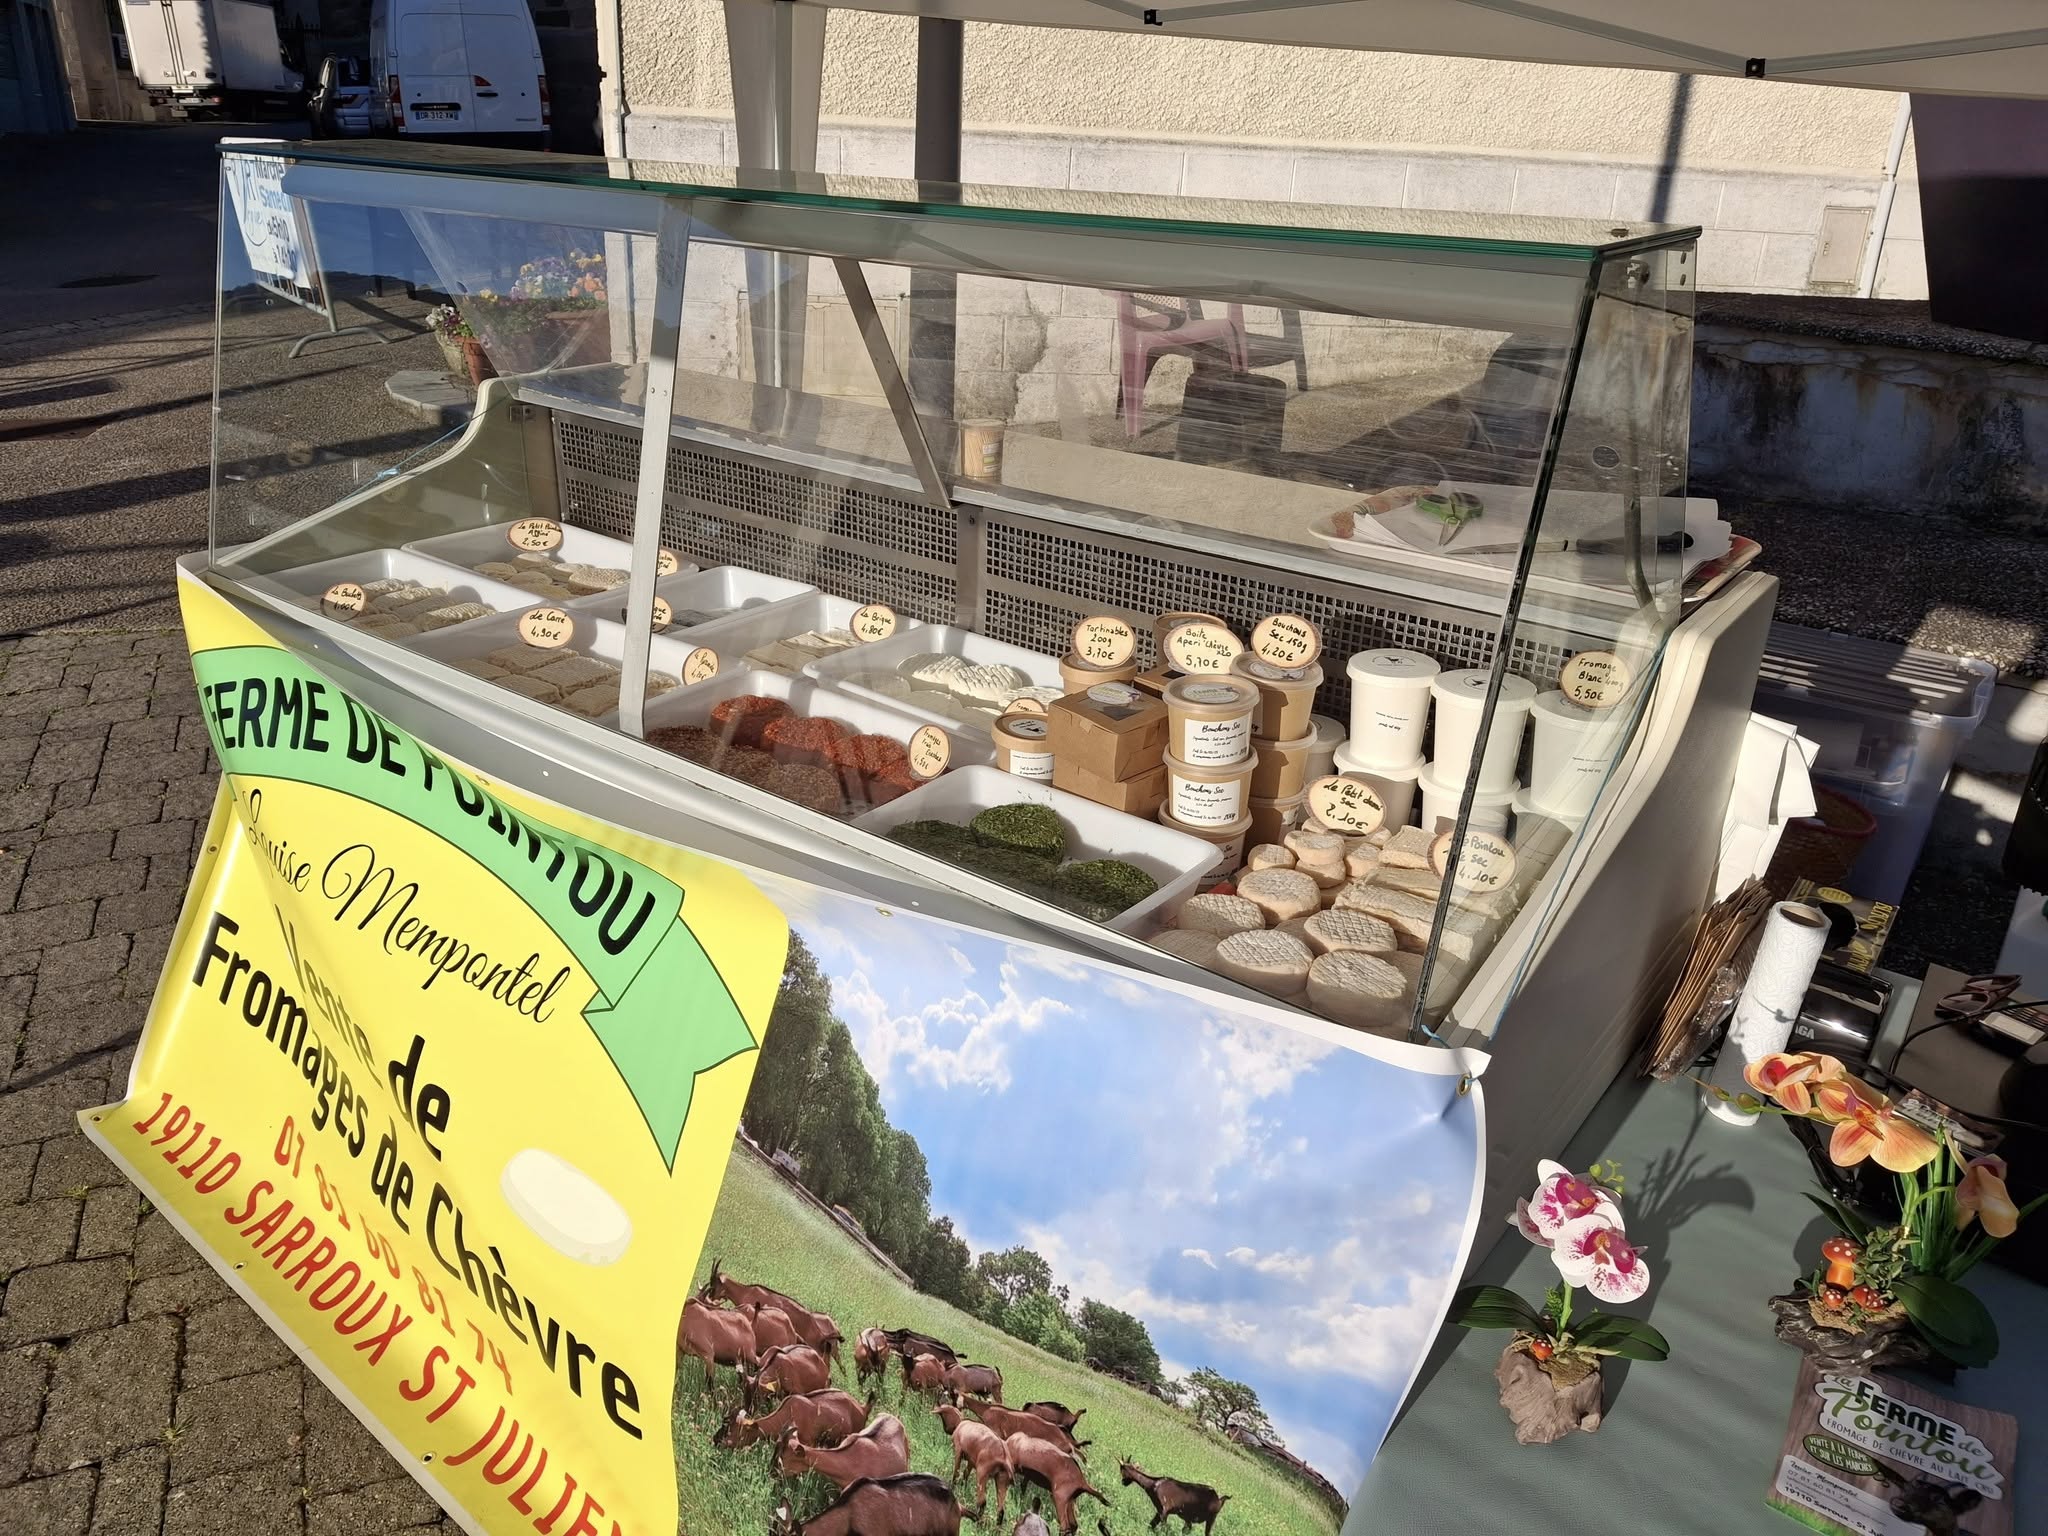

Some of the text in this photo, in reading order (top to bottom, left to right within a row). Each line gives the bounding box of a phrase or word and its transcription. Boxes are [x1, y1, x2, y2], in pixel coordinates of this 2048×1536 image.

[546, 610, 568, 624] Carré
[1578, 670, 1602, 683] Blanc
[203, 676, 657, 957] FERME DE POINTOU
[1470, 835, 1506, 858] Pointou
[242, 787, 572, 1023] Louise Mempontel
[273, 903, 452, 1163] Vente de
[191, 911, 643, 1440] Fromages de Chèvre
[133, 1090, 241, 1194] 19110
[224, 1180, 413, 1367] SARROUX
[398, 1345, 478, 1424] ST
[1808, 1436, 1829, 1450] VENTE
[1822, 1387, 1996, 1481] Pointou
[1826, 1417, 1868, 1445] FROMAGE
[1872, 1440, 1885, 1452] DE
[1930, 1462, 1944, 1474] AU
[1855, 1380, 1958, 1447] FERME
[1957, 1440, 1985, 1458] de
[1832, 1453, 1845, 1467] LES
[1784, 1486, 1813, 1503] 19110
